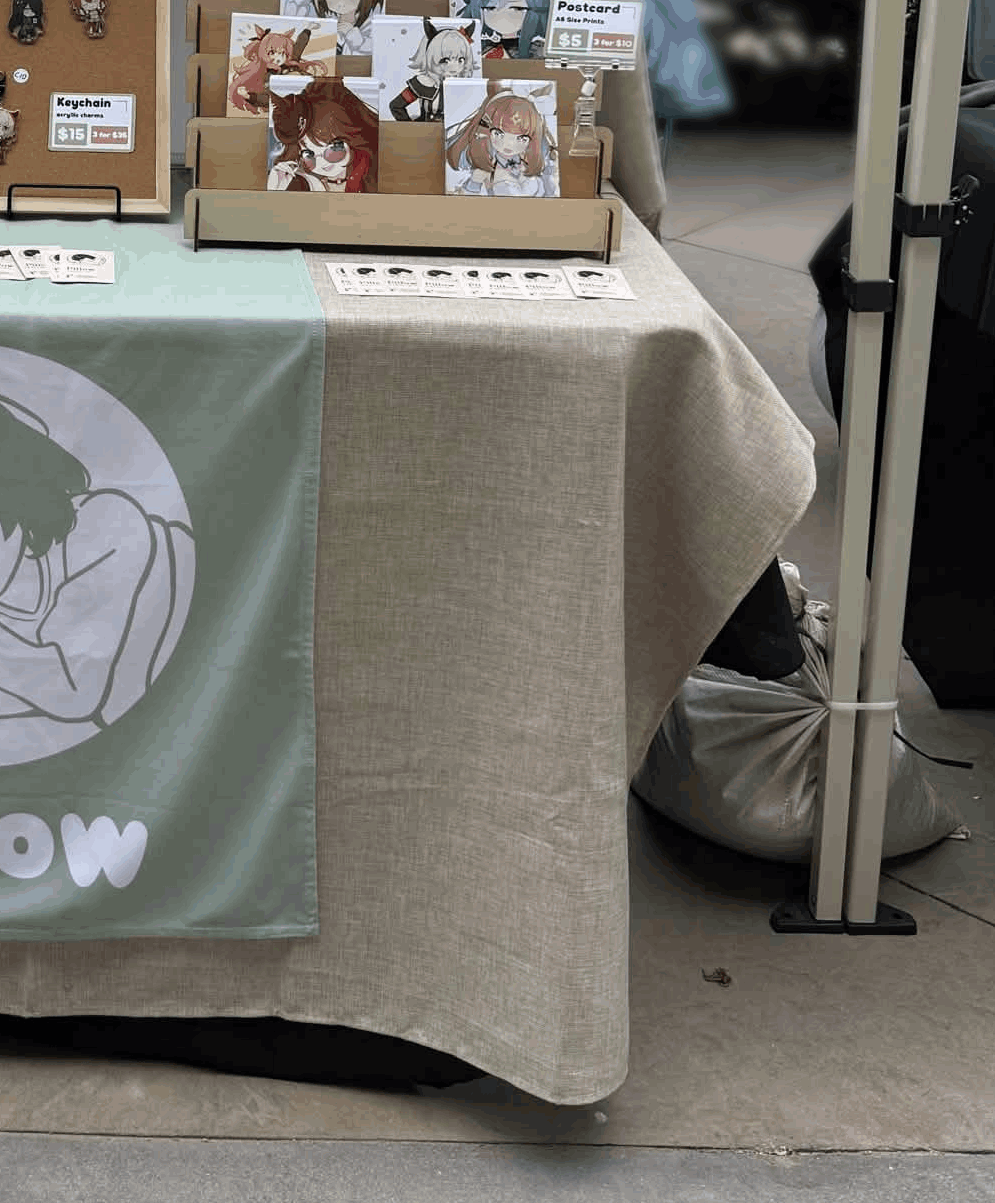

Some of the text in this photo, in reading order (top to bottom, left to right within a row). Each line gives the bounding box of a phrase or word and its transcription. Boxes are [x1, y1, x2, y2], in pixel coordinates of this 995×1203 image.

[558, 1, 621, 14] Postcard
[559, 32, 582, 47] $5
[57, 97, 111, 109] Keychain
[58, 126, 85, 142] $15
